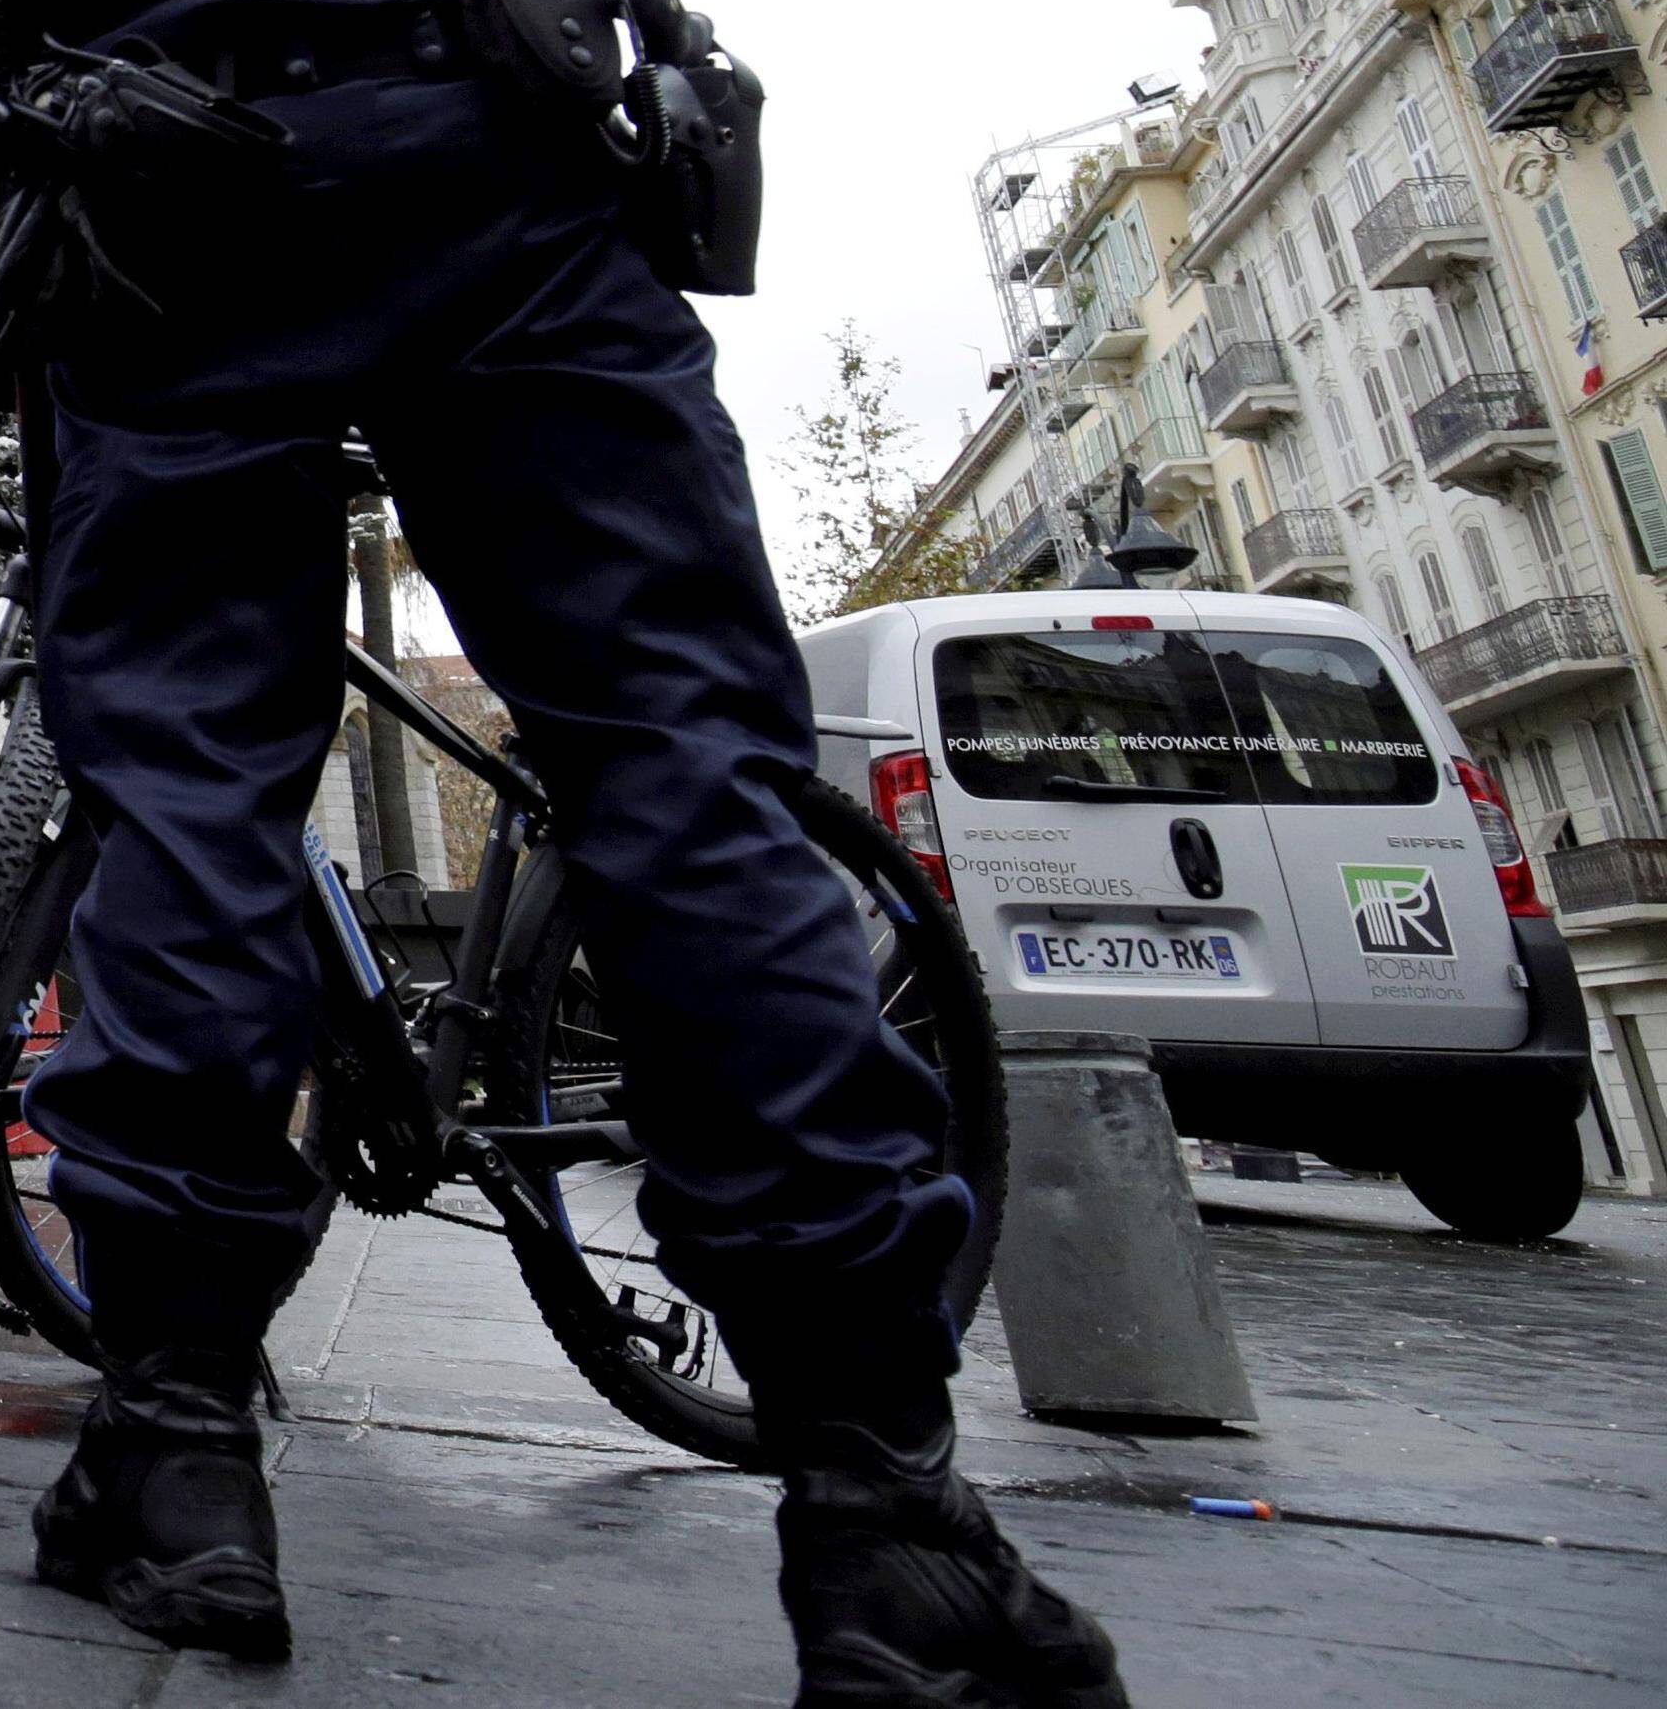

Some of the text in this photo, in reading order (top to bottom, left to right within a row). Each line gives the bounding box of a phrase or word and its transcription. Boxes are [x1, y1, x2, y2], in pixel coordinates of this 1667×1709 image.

[947, 732, 1428, 759] POMPES FUNÈBRES PRÉVOYANCE FUNÉRAIRE MARBRERIE
[964, 828, 1071, 842] PEUGEOT
[1387, 836, 1466, 851] BIPPER
[949, 854, 1078, 876] Organisateur
[1041, 937, 1216, 971] EC-370-RK
[1219, 959, 1236, 973] 06
[1365, 958, 1457, 981] ROBAUT
[1372, 983, 1466, 1001] prestations
